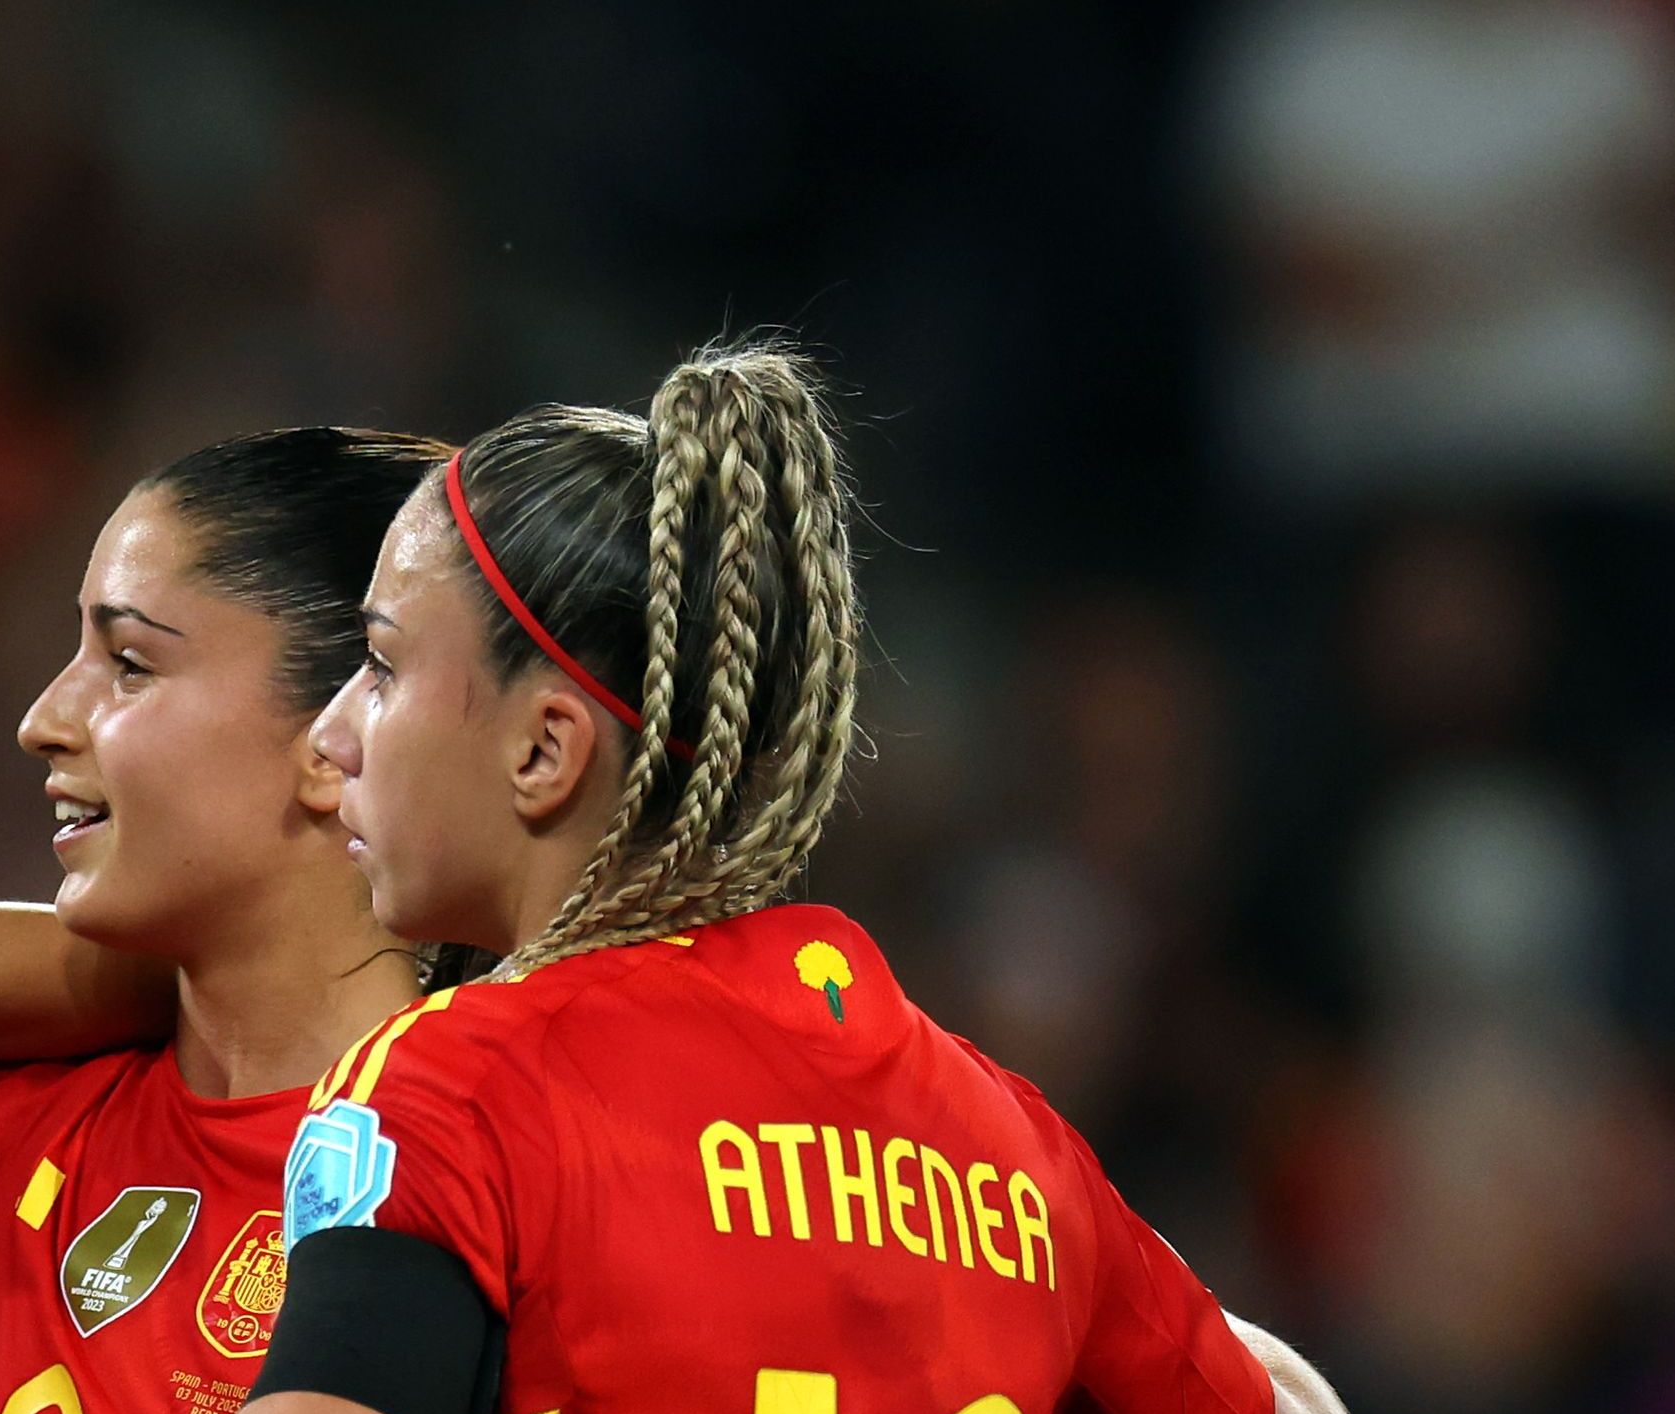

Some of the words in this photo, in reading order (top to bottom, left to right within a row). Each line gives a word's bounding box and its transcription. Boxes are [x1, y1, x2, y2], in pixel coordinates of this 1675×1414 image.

[699, 1120, 1055, 1292] ATHENEA
[81, 1268, 125, 1293] FIFA
[81, 1298, 105, 1312] 2023
[169, 1370, 201, 1388] SPAIN
[210, 1380, 251, 1400] PORTUG
[175, 1386, 191, 1400] 03
[191, 1391, 217, 1407] JULY
[216, 1398, 242, 1414] 2025
